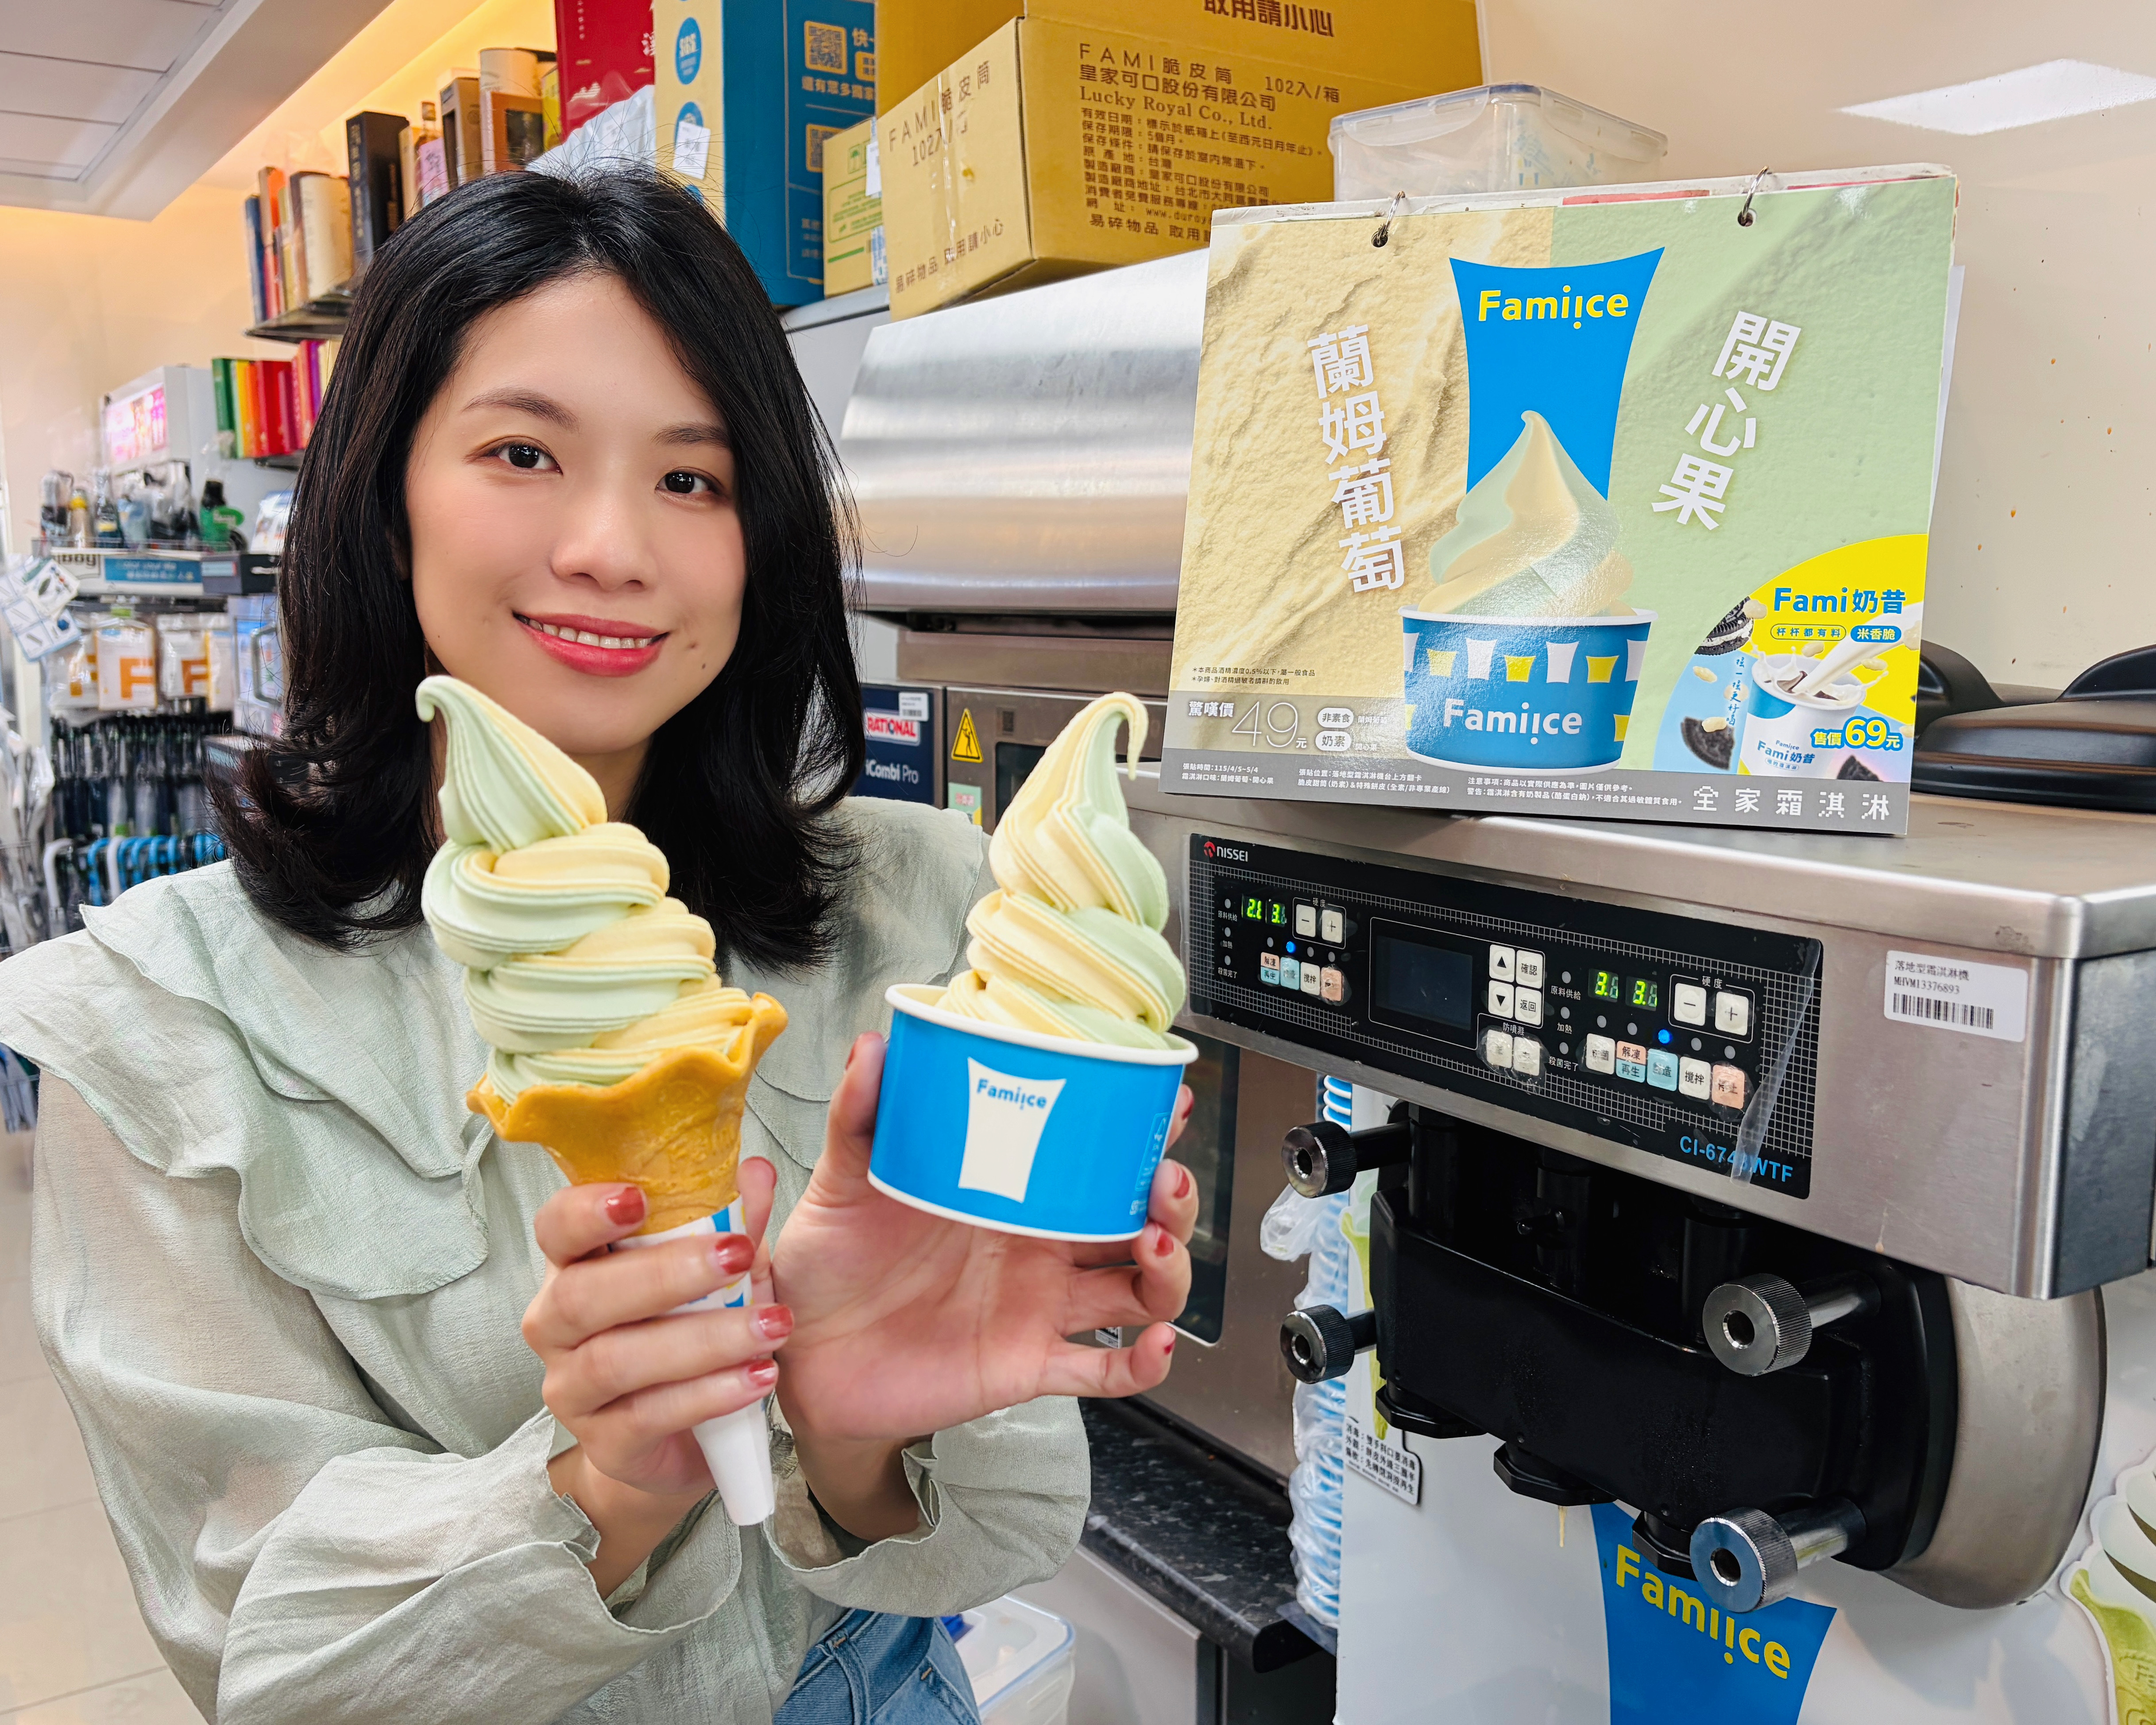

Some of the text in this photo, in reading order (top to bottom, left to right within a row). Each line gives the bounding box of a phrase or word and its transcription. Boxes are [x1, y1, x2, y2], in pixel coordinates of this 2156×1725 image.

[1079, 64, 1276, 112] 皇家可口股份有限公司
[1265, 76, 1340, 103] 102入/箱
[1079, 86, 1273, 130] Lucky Royal Co., Ltd.
[1651, 310, 1801, 530] 開心果
[1307, 324, 1405, 593] 蘭姆葡萄
[1857, 628, 1896, 641] 米香脆
[1322, 712, 1350, 723] 非素食
[868, 716, 916, 738] RATIONAL
[1321, 735, 1345, 747] 奶素
[865, 758, 920, 785] iCombi Pro
[1693, 785, 1890, 820] 全家霜淇淋
[1216, 846, 1248, 862] NISSEI
[1521, 963, 1538, 976] 確認
[1895, 959, 1970, 981] 落地型霜淇淋機
[1702, 975, 1723, 989] 硬度
[1550, 985, 1581, 1001] 原料供給
[1520, 999, 1536, 1013] 返回
[1557, 1022, 1573, 1034] 加熱
[1621, 1046, 1641, 1060] 解凍
[1548, 1056, 1579, 1072] 殺菌完了
[1621, 1063, 1640, 1078] 再生
